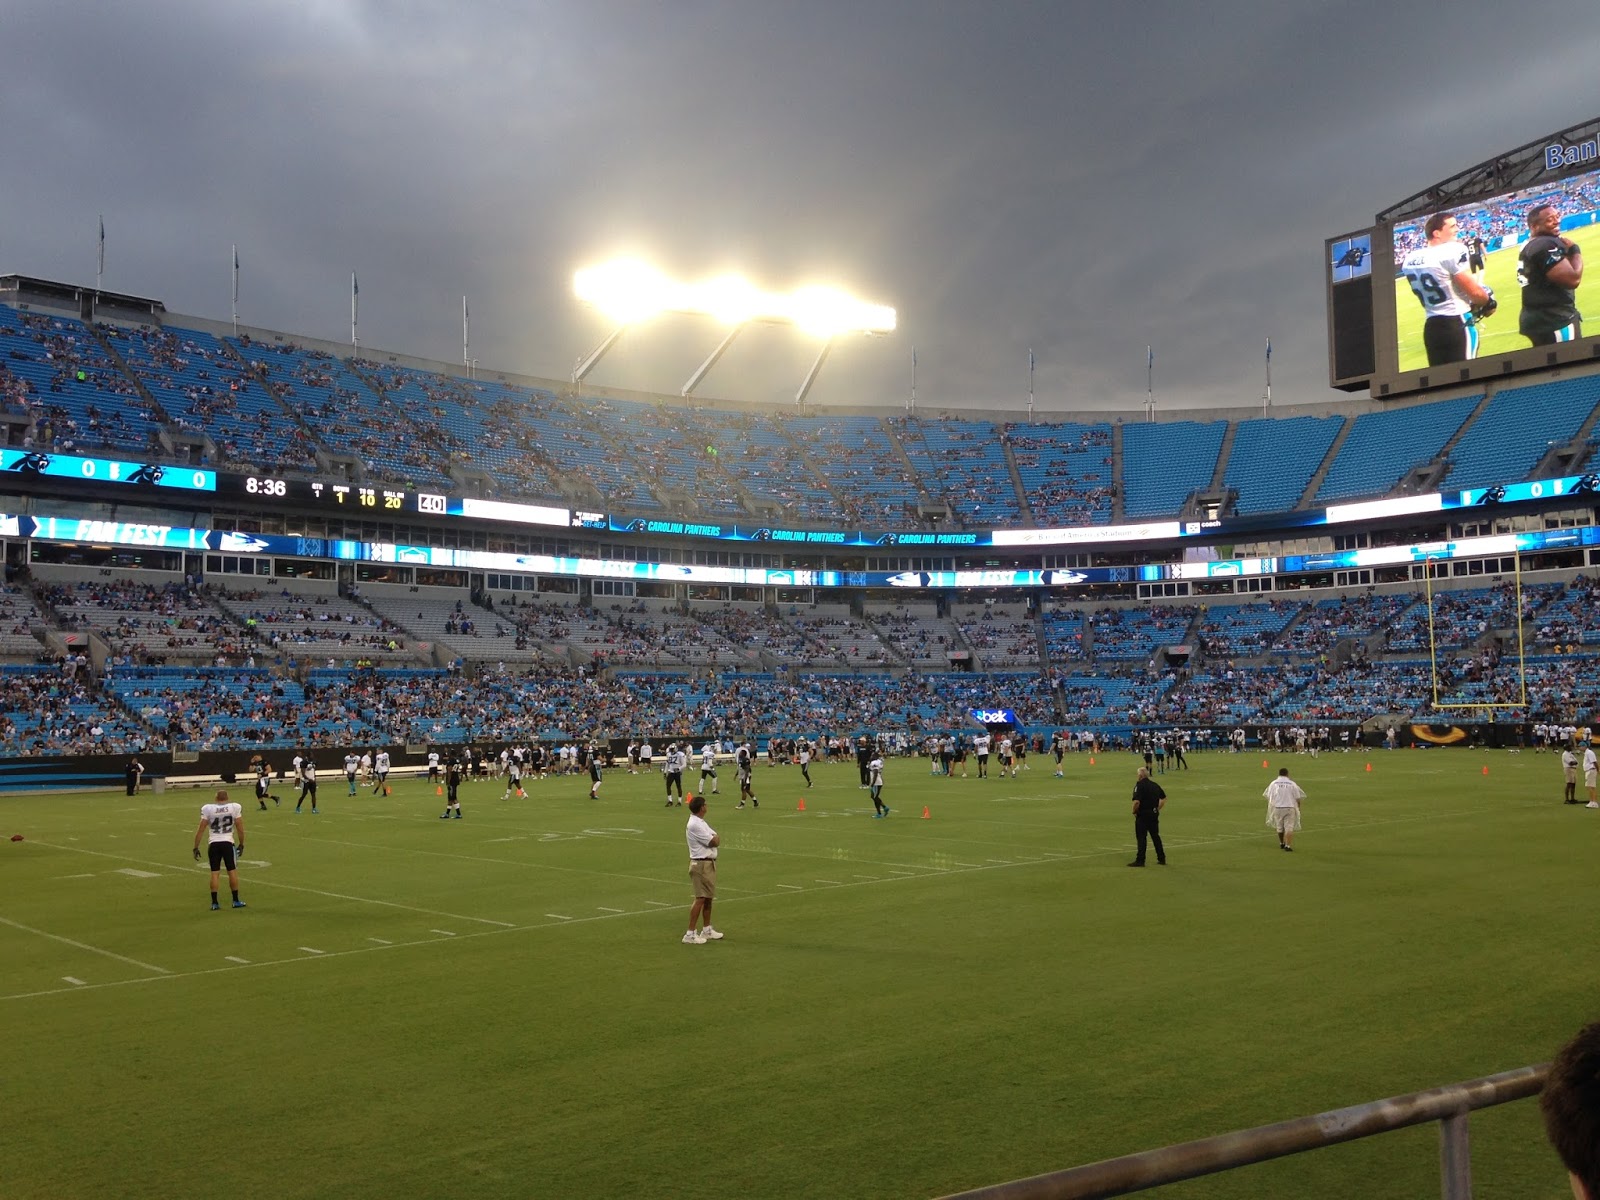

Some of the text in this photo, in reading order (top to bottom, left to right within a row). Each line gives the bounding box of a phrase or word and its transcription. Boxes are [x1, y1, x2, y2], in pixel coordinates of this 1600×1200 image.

[81, 459, 96, 477] 0
[193, 471, 206, 488] 0
[246, 477, 286, 496] 8:36
[314, 490, 320, 498] 1
[336, 491, 343, 503] 1
[1530, 482, 1543, 498] 0
[359, 494, 376, 506] 10
[384, 496, 401, 509] 20
[119, 523, 171, 546] FEST
[648, 521, 720, 537] CAROLINA PANTHERS
[772, 530, 845, 543] CAROLINA PANTHERS
[898, 534, 976, 544] CAROLINA PANTHERS
[210, 815, 234, 833] 42
